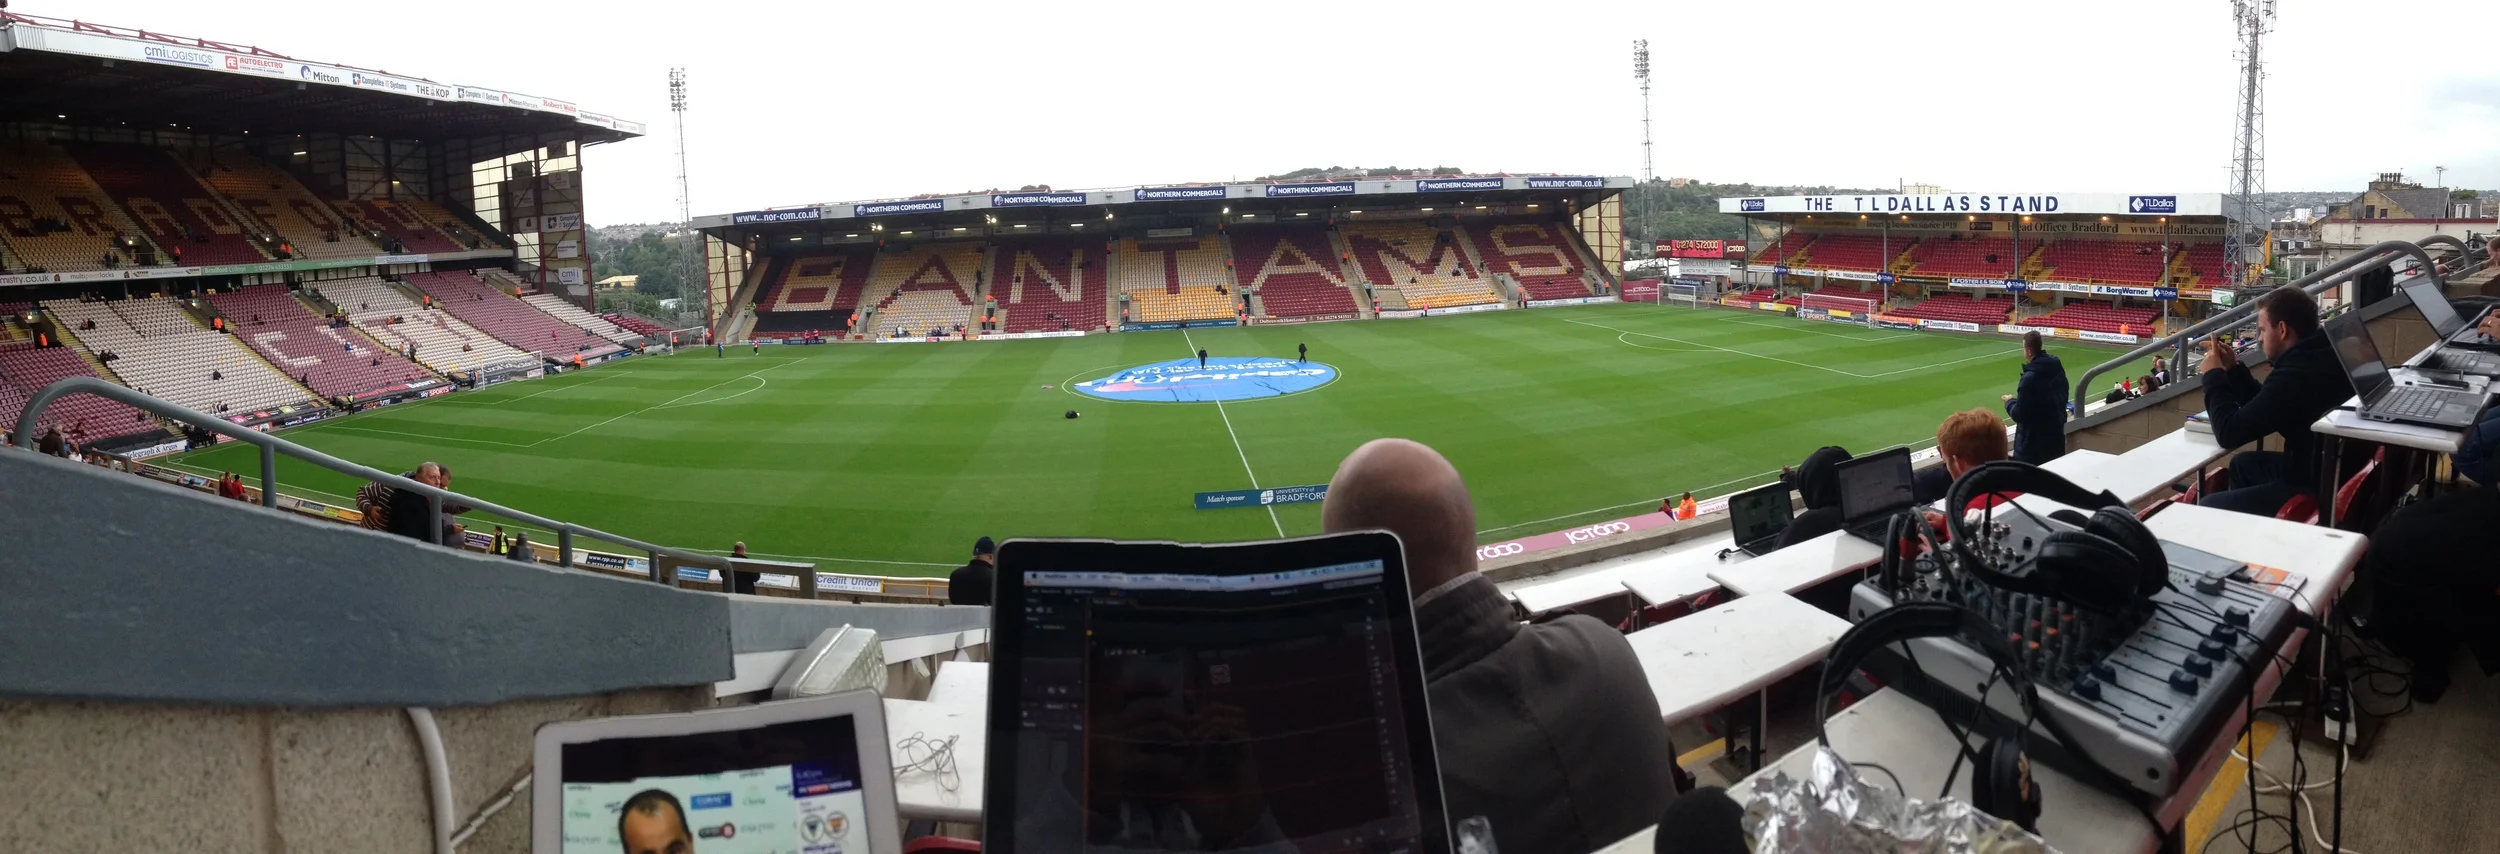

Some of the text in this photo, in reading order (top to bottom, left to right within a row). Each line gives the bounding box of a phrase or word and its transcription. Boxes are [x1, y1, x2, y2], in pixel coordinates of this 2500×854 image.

[240, 57, 284, 68] AUTOELECTRO
[313, 71, 340, 83] Mitton
[390, 81, 407, 90] Systems
[416, 84, 450, 98] THE KOP
[486, 92, 499, 101] Systems
[1530, 180, 1602, 188] www.nor-com.co.uk
[1805, 197, 1832, 211] THE
[1980, 196, 2058, 212] STAND
[2144, 199, 2174, 208] TLDallas
[2072, 222, 2119, 233] Bradford
[1676, 240, 1718, 249] 01274 572000
[2106, 286, 2148, 295] BorgWarner
[429, 386, 449, 396] SPORTS
[127, 447, 155, 458] Telegraph
[162, 444, 178, 452] Argus
[1226, 495, 1245, 504] sponsor
[1565, 522, 1630, 545] JCT600
[1476, 543, 1523, 560] T600
[851, 577, 879, 586] Union
